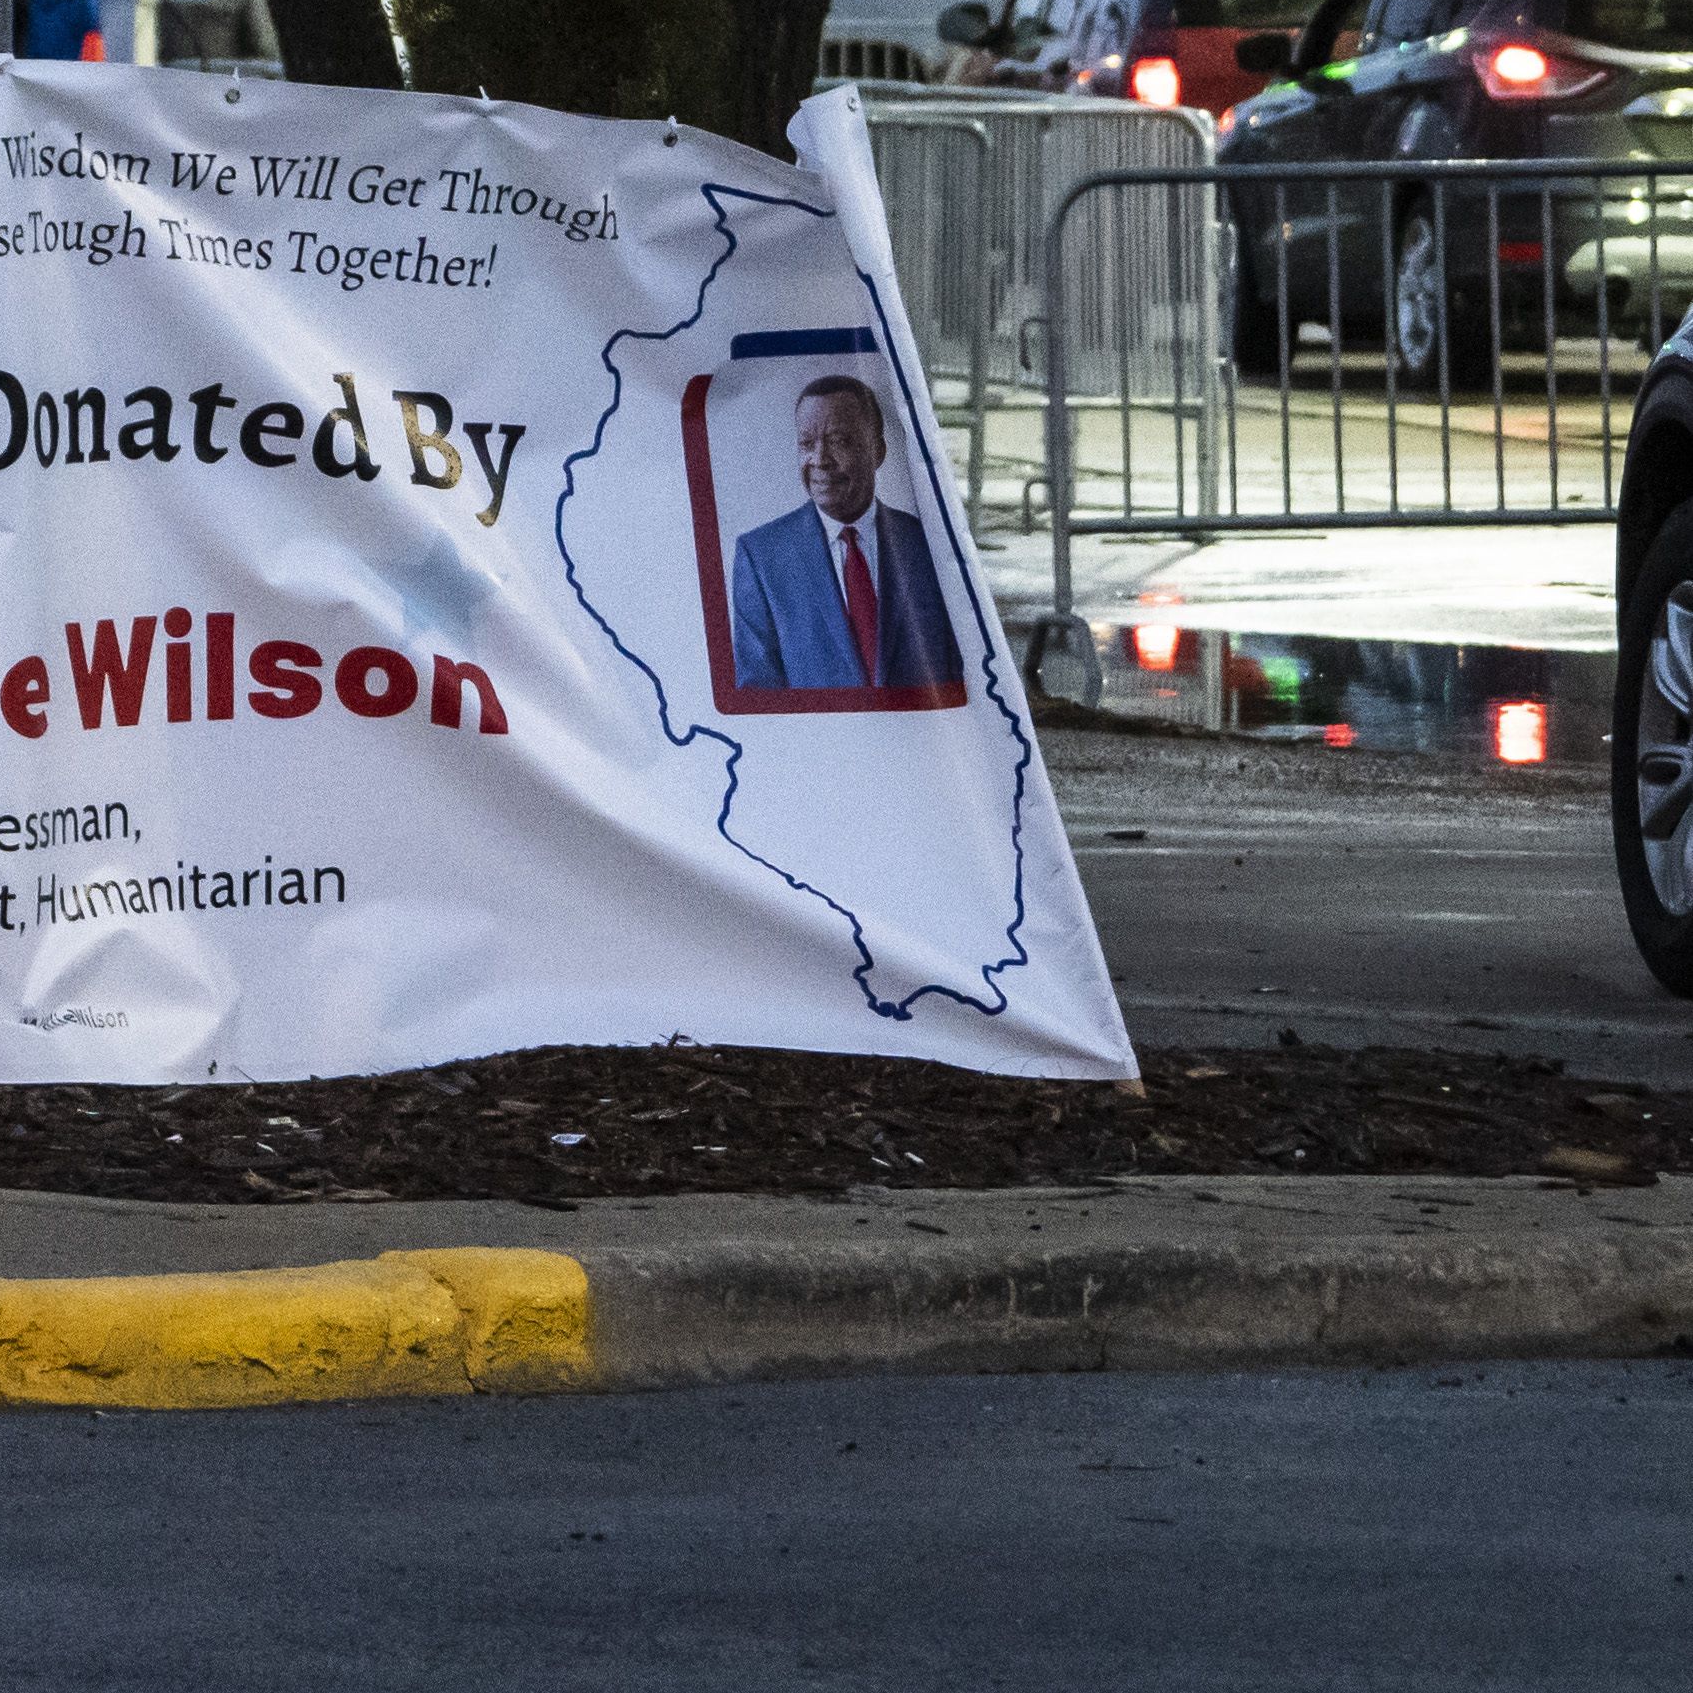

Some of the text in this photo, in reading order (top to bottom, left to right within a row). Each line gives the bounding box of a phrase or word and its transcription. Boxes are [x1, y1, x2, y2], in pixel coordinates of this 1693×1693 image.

[1, 131, 151, 186] Wisdom
[169, 151, 238, 196] We
[249, 155, 341, 202] Will
[346, 164, 427, 208] Get
[438, 167, 620, 243] Through
[27, 210, 147, 266] Tough
[158, 217, 274, 271] Times
[287, 230, 499, 292] Together!
[391, 389, 527, 528] By
[64, 605, 509, 735] Wilson
[34, 854, 346, 925] Humanitarian
